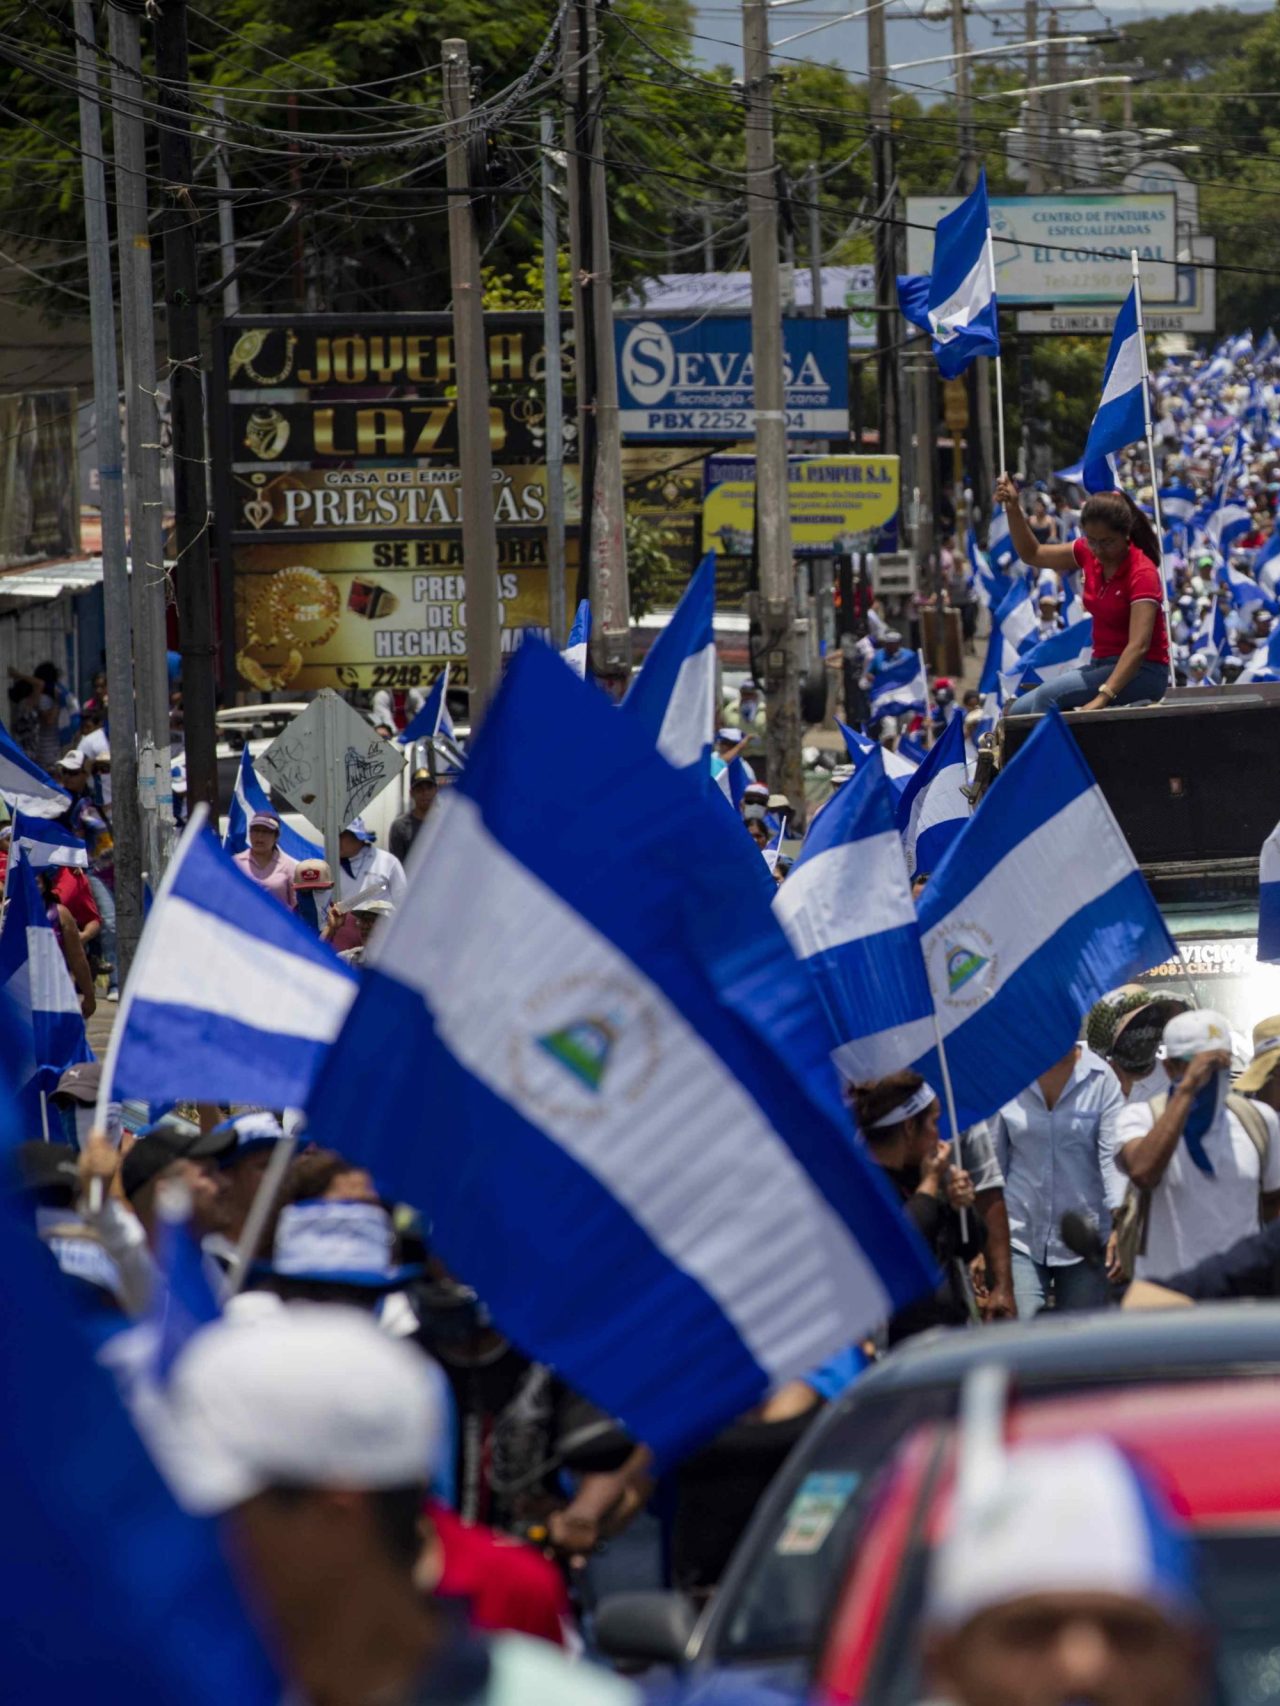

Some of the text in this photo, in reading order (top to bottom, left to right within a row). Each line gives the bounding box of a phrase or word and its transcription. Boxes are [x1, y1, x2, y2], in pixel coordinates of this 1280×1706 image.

[1032, 210, 1167, 223] CENTRO DE PINTURAS
[1048, 224, 1152, 236] ESPECIALIZADAS
[1034, 246, 1166, 264] EL COLONIAL
[1050, 317, 1099, 330] CLINICA
[297, 333, 524, 383] JOYEA
[648, 412, 694, 430] PBX
[698, 412, 747, 430] 2252
[325, 469, 504, 485] CASA DE EMPO
[372, 538, 547, 568] SE ELARA
[427, 604, 453, 628] DE
[375, 629, 466, 657] HECHAS
[371, 666, 467, 689] 2248-221
